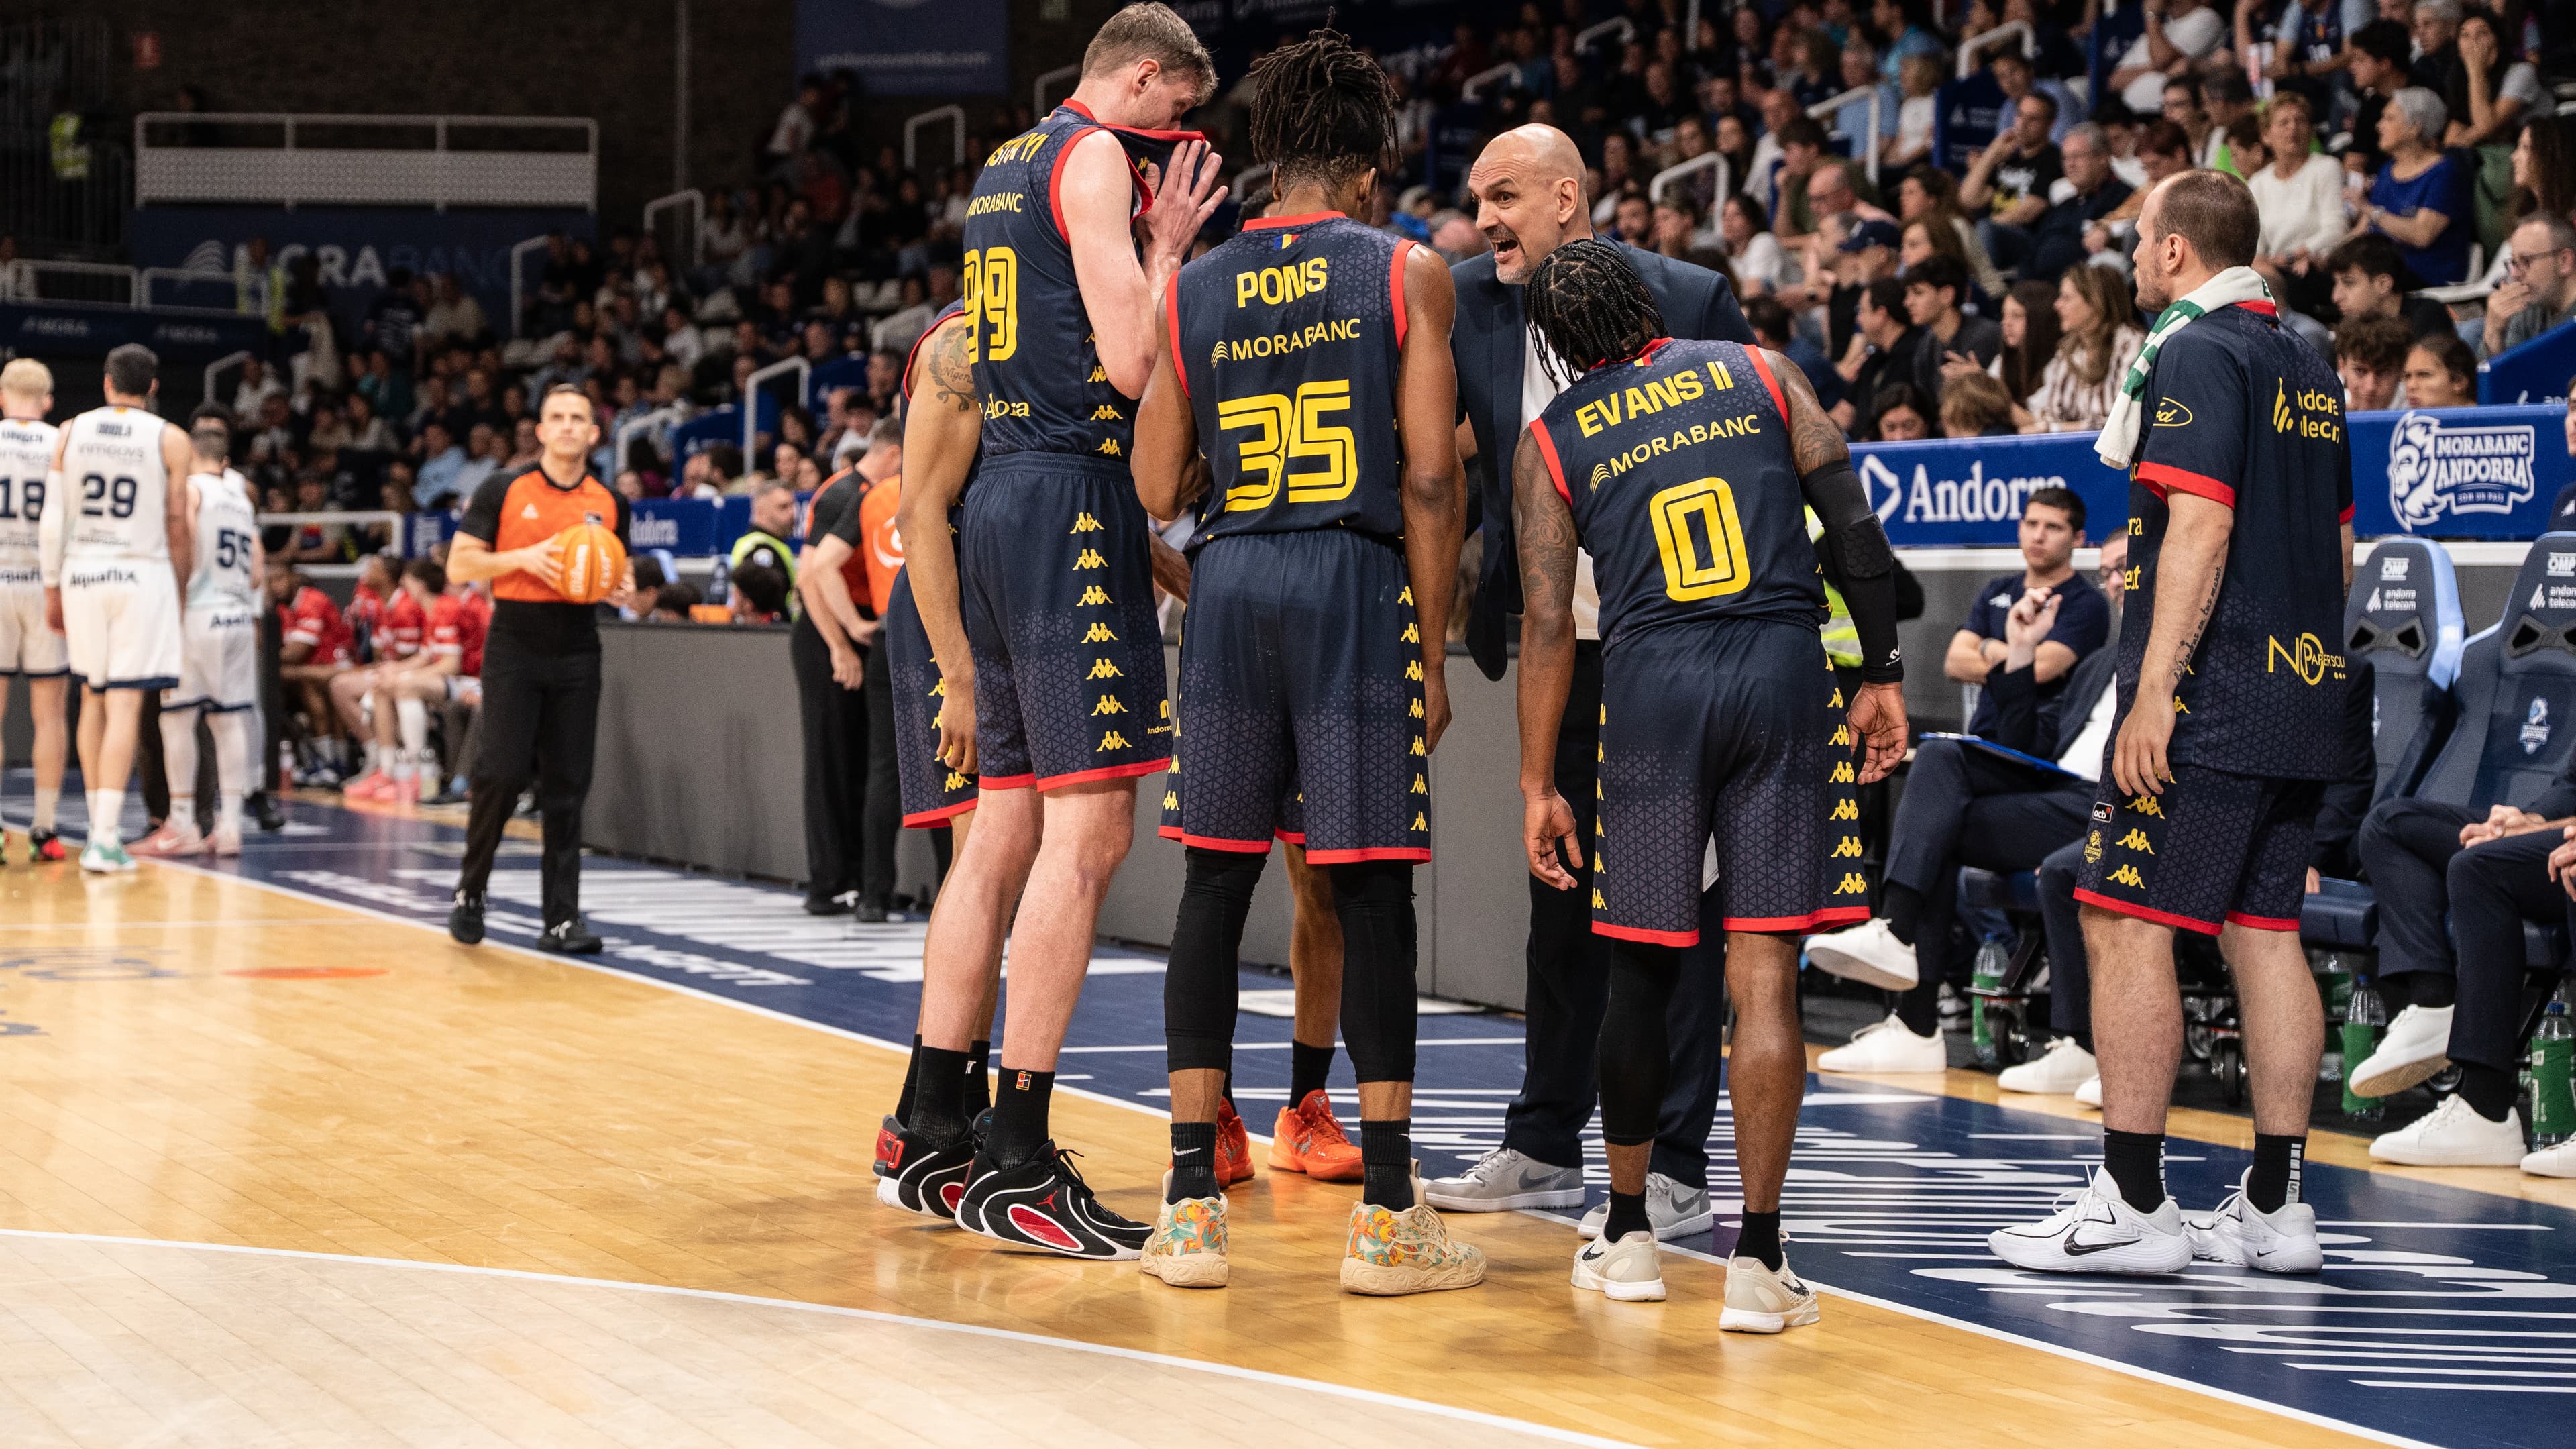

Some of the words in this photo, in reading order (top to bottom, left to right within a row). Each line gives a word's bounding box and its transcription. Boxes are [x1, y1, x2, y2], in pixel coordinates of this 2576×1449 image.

[1236, 257, 1328, 308] PONS
[1574, 370, 1705, 439] EVANS
[1707, 360, 1734, 391] II
[1218, 379, 1358, 513] 35
[1609, 414, 1761, 478] MORABANC
[2436, 434, 2529, 457] MORABANC
[82, 473, 138, 519] 29
[1904, 460, 2067, 523] Andor
[2436, 457, 2529, 490] ANDORRA
[0, 477, 46, 521] 18
[1649, 476, 1750, 602] 0
[2384, 599, 2416, 611] telecom
[2385, 588, 2416, 599] andorra
[2548, 596, 2576, 610] teleco
[2094, 810, 2106, 819] acb
